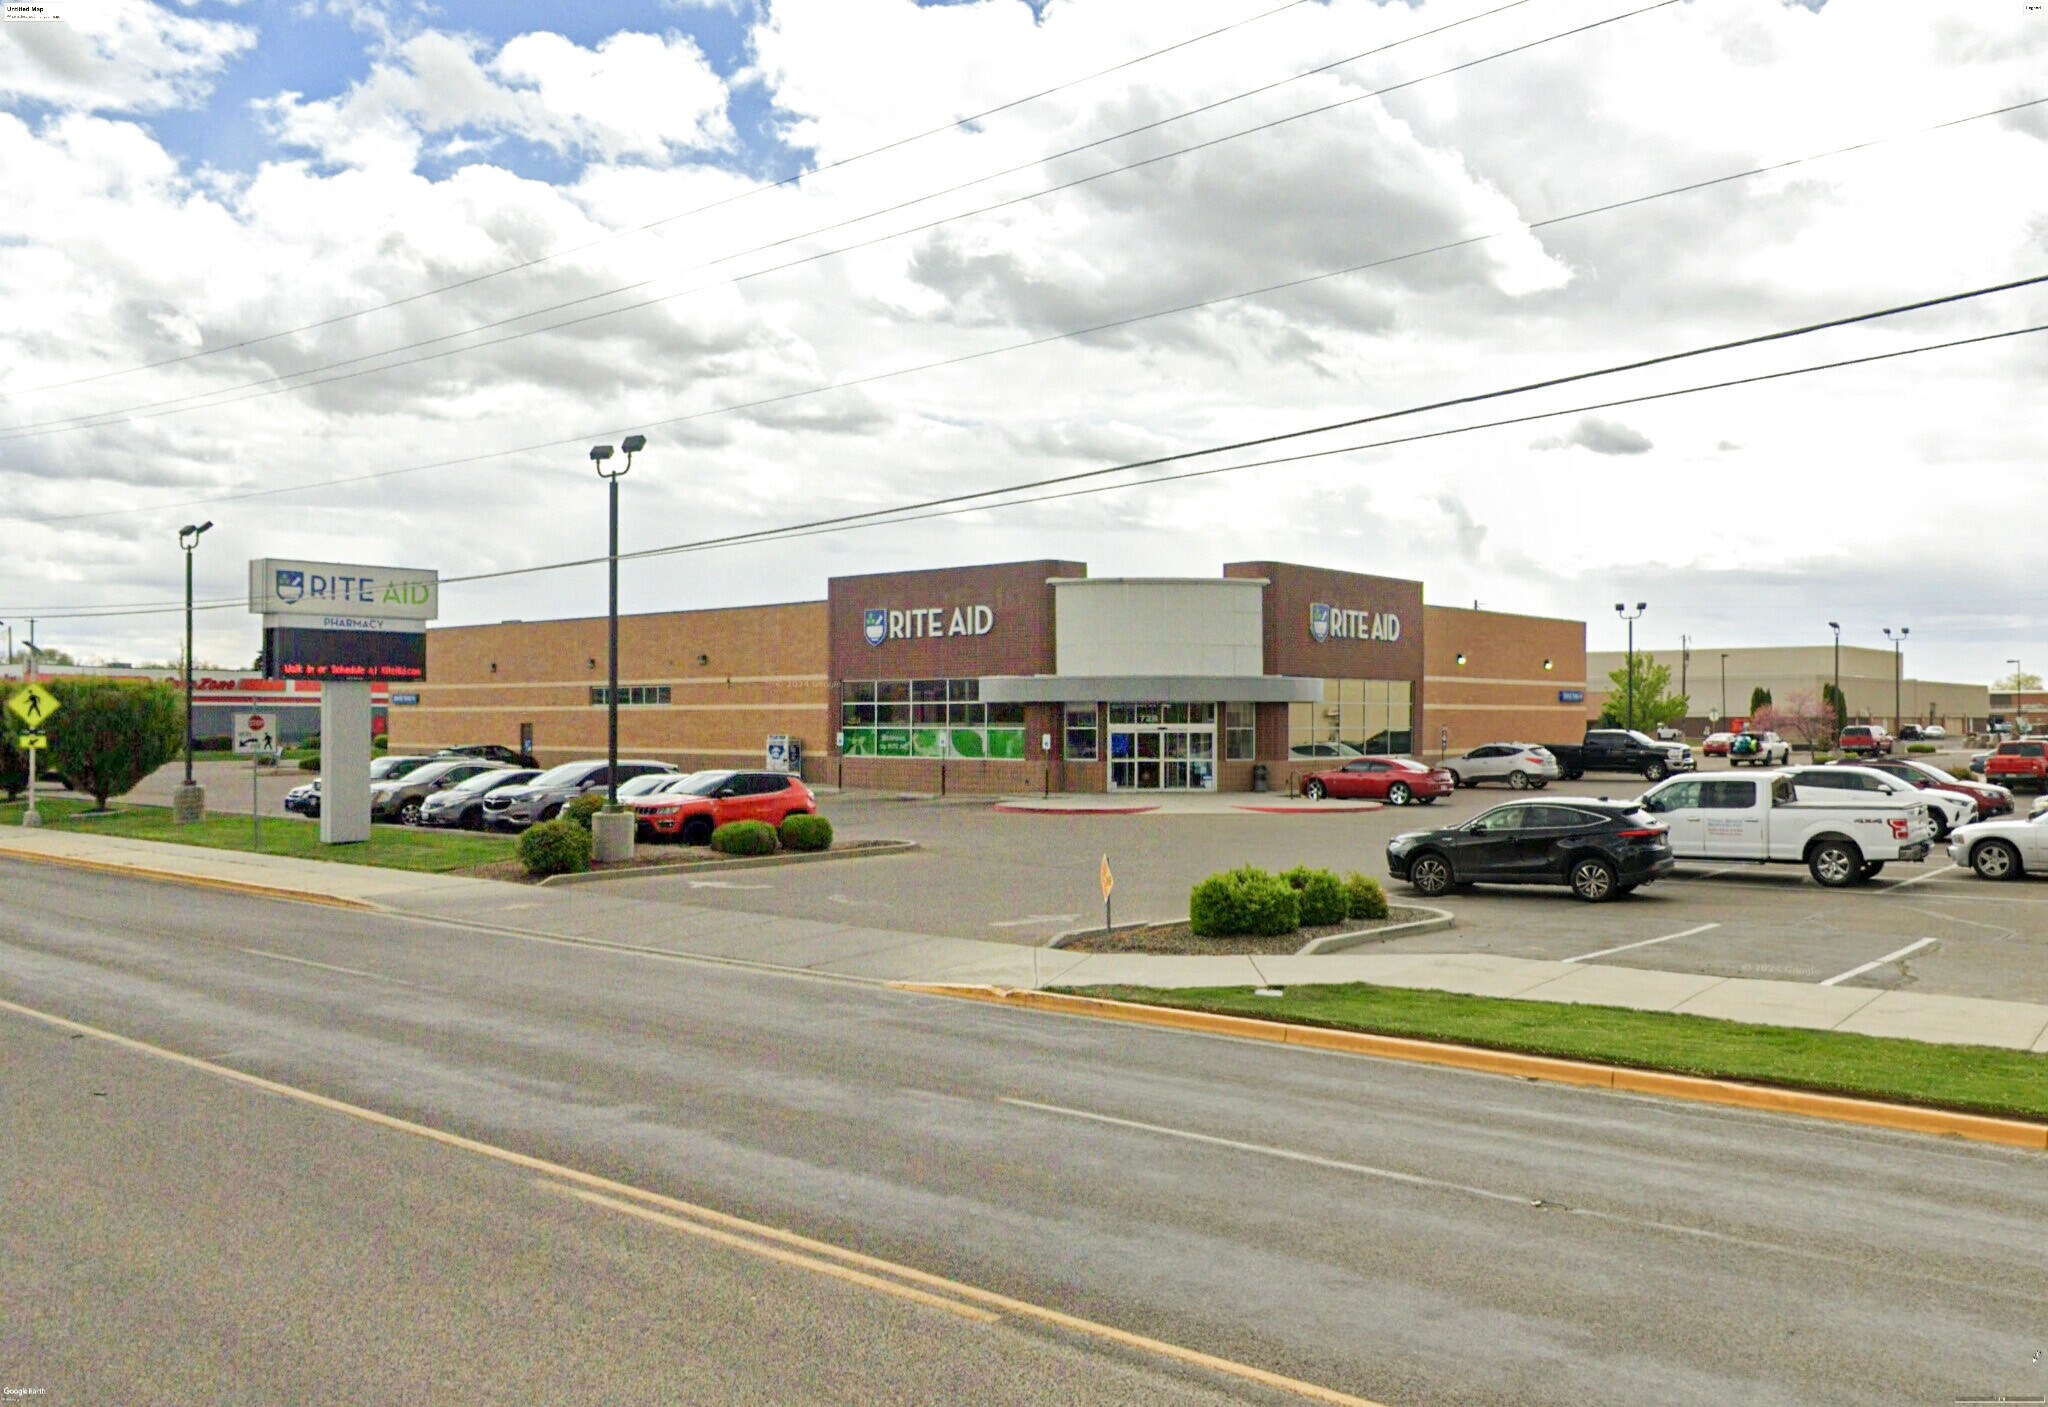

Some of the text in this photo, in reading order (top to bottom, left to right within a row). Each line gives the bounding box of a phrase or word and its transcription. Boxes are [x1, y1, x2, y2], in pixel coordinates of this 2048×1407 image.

[310, 575, 430, 605] RITE AID
[323, 617, 384, 630] PHARMACY
[889, 605, 994, 639] RITE AID
[1329, 607, 1401, 642] RITE AID
